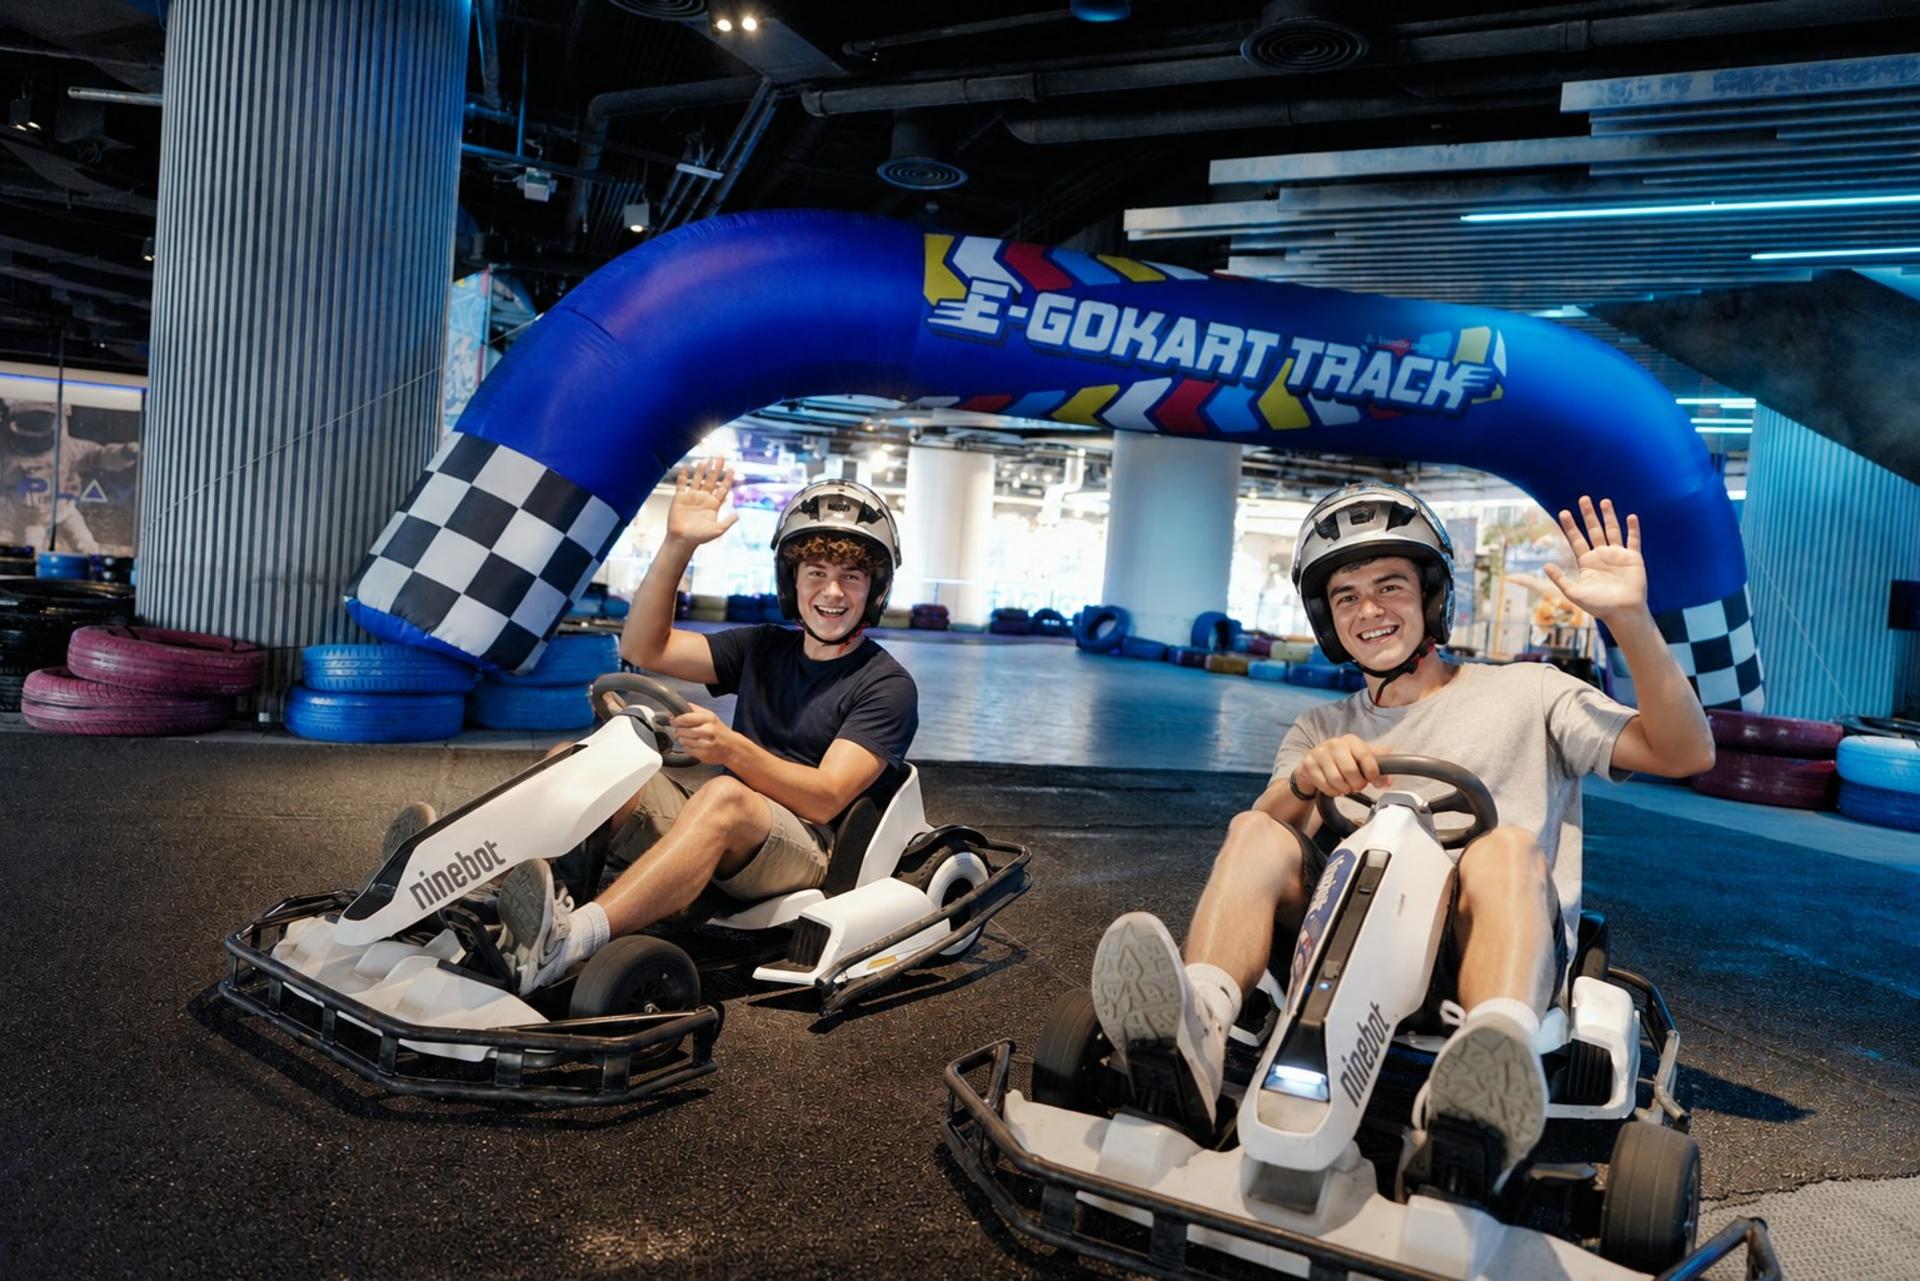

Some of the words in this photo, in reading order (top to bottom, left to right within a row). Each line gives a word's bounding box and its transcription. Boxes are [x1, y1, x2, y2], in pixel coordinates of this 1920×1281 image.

[927, 278, 1279, 379] E-GOKART
[1289, 336, 1495, 410] TRACK
[408, 840, 507, 911] ninebot
[1339, 1000, 1391, 1108] ninebot
